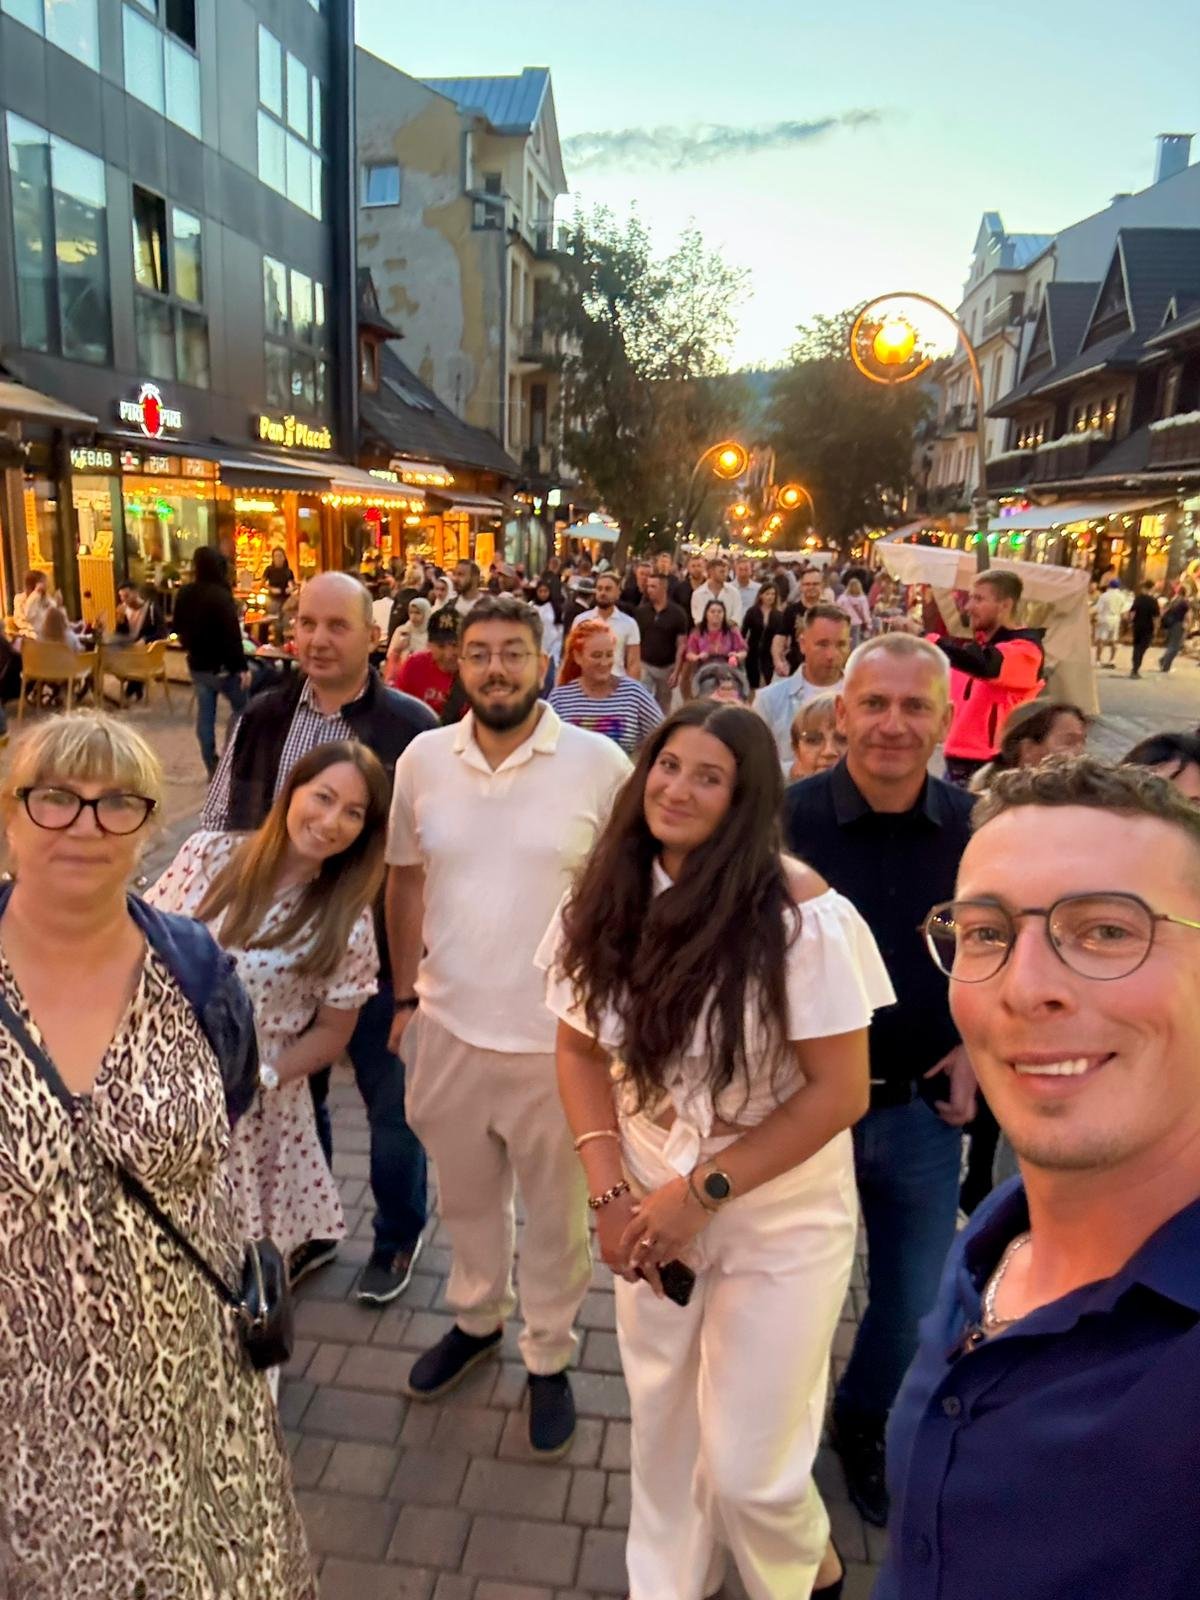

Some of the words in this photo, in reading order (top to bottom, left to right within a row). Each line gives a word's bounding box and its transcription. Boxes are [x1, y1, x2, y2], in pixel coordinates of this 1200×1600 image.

[120, 401, 144, 422] PIRI
[160, 408, 182, 428] PIRI
[260, 416, 284, 441] Pan
[70, 448, 112, 467] KEBAB
